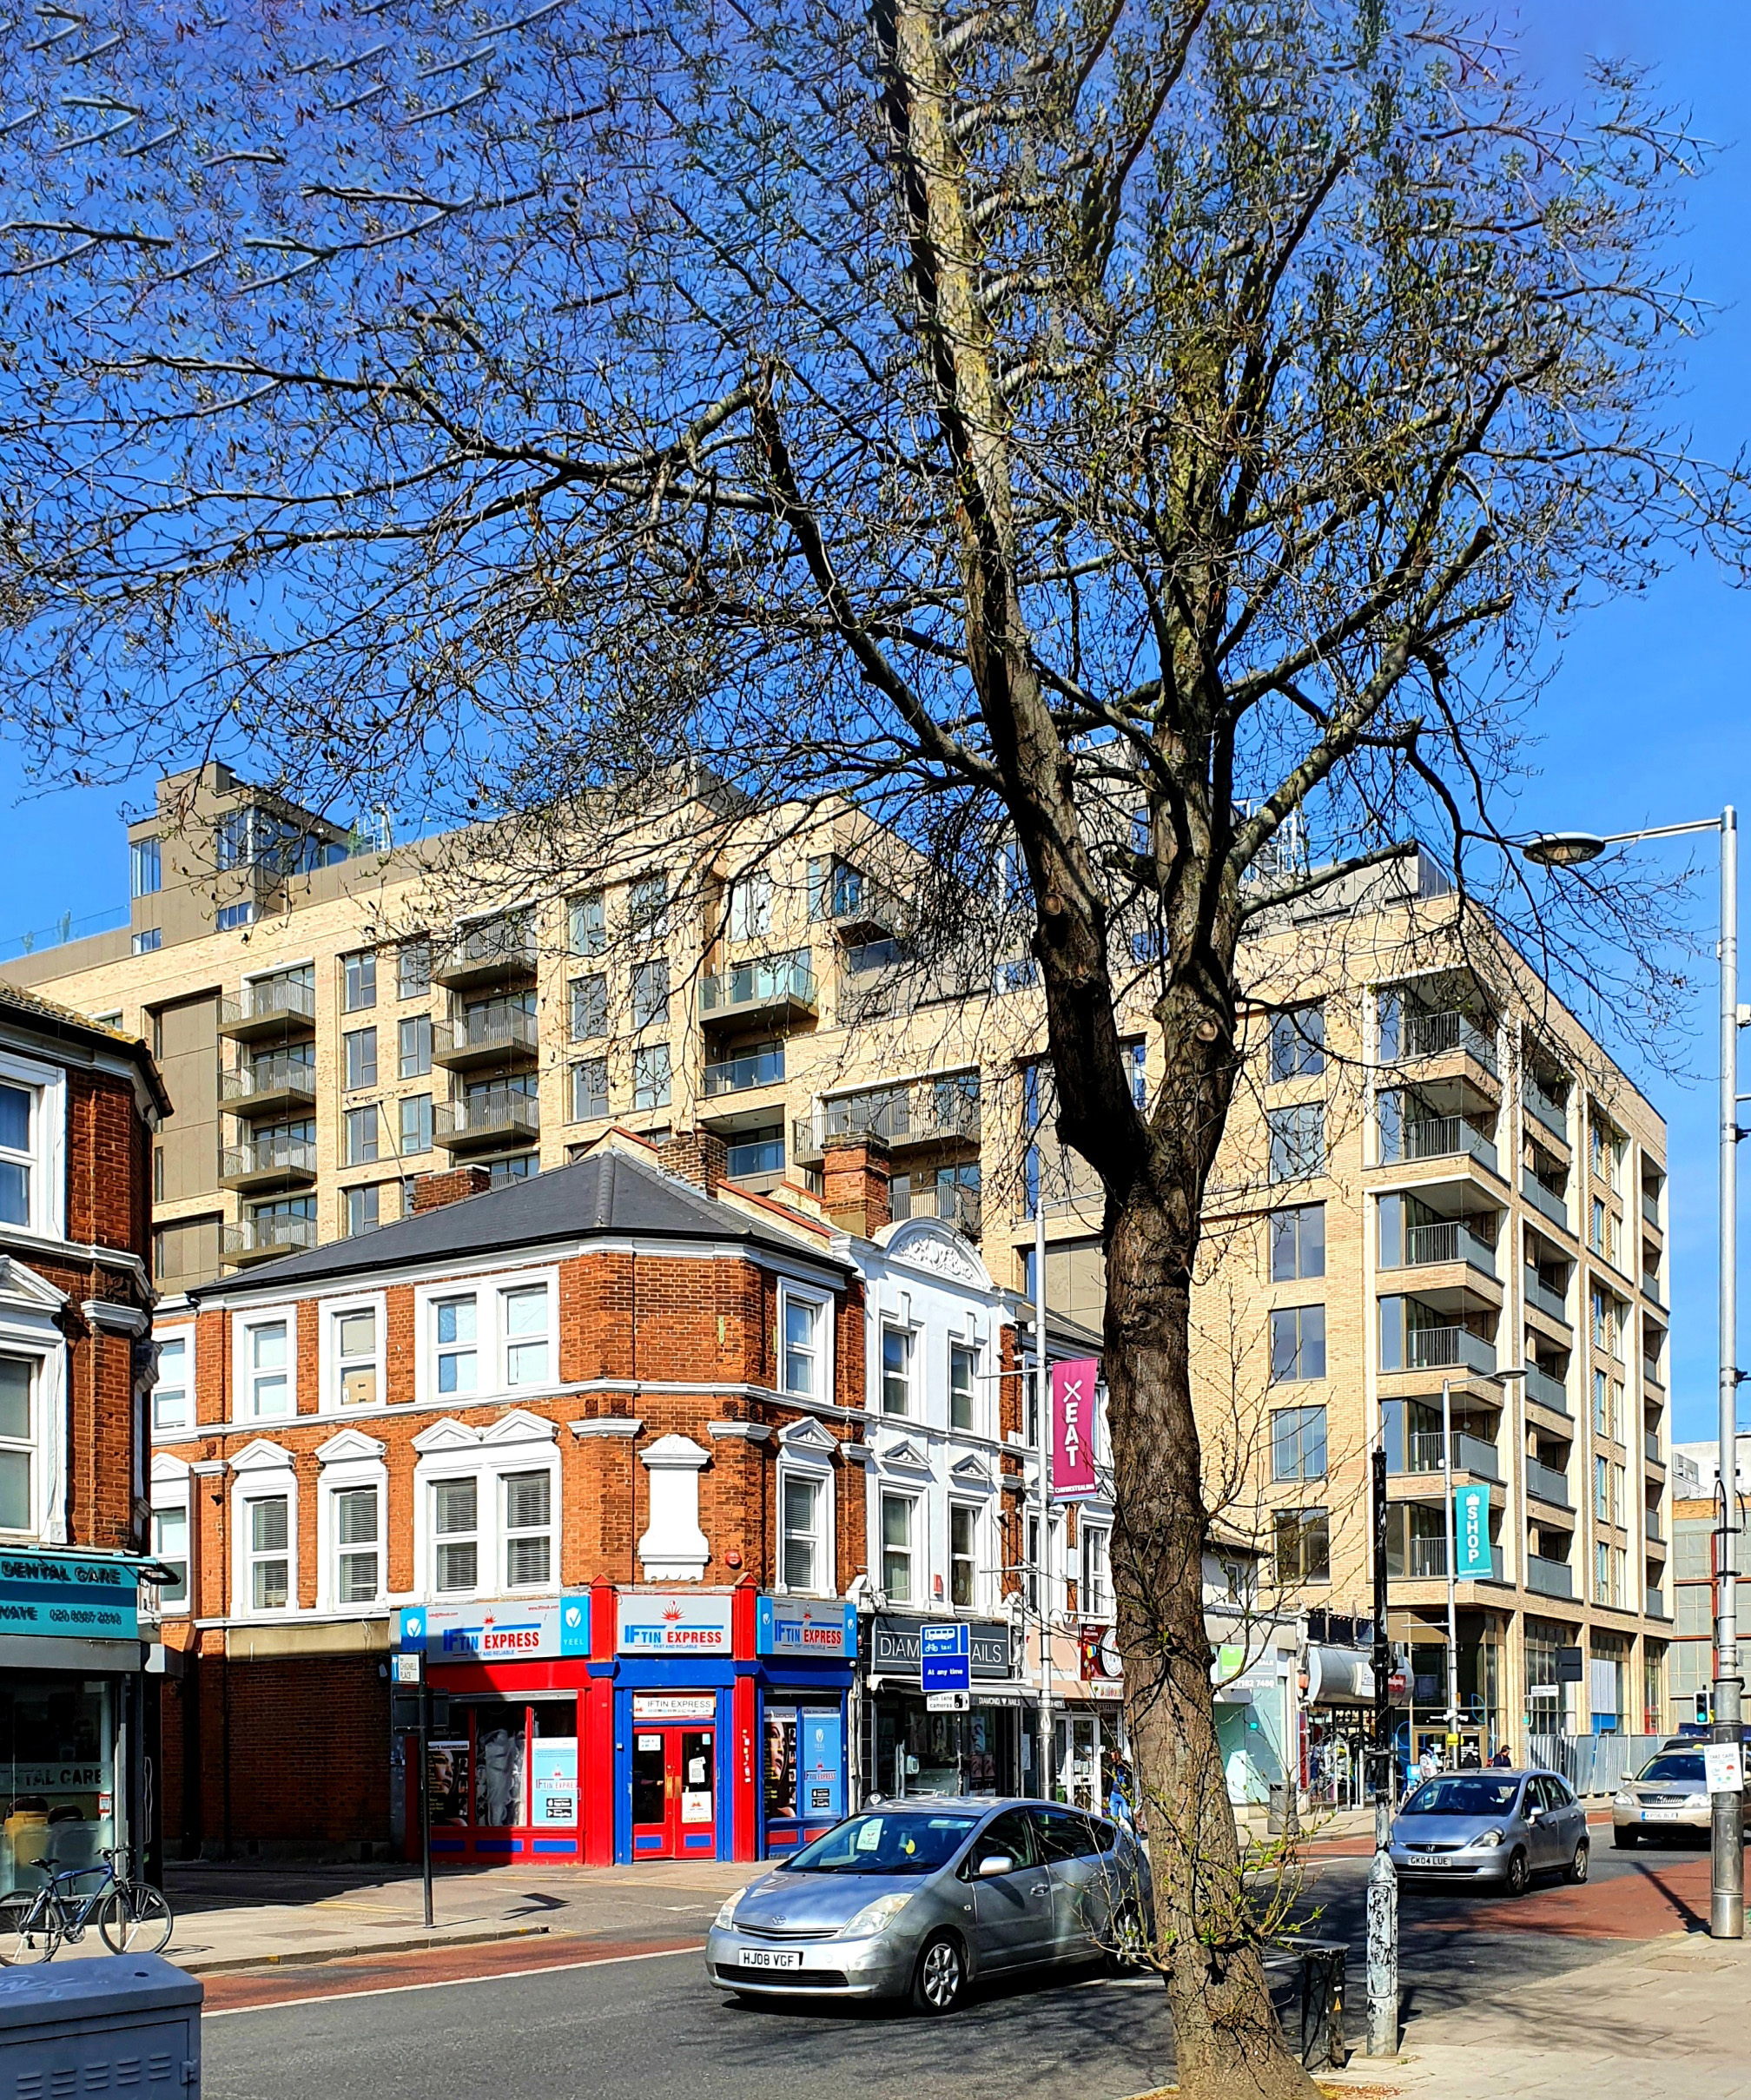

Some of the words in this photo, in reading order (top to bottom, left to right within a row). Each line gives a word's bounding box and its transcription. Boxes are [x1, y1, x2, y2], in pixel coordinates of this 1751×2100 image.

[1064, 1402, 1079, 1467] EAT
[1466, 1505, 1479, 1563] SHOP
[2, 1561, 71, 1582] DENTAL
[74, 1566, 122, 1585] CARE
[484, 1631, 539, 1649] EXPRESS
[624, 1625, 662, 1643] IFTIN
[667, 1631, 722, 1643] EXPRESS
[775, 1620, 800, 1642] IFTIN
[803, 1629, 842, 1644] EXPRESS
[880, 1636, 920, 1657] DIAM
[972, 1643, 1002, 1663] AILS
[1411, 1856, 1431, 1865] GK04
[743, 1952, 770, 1965] HJ08
[773, 1954, 794, 1966] VGF
